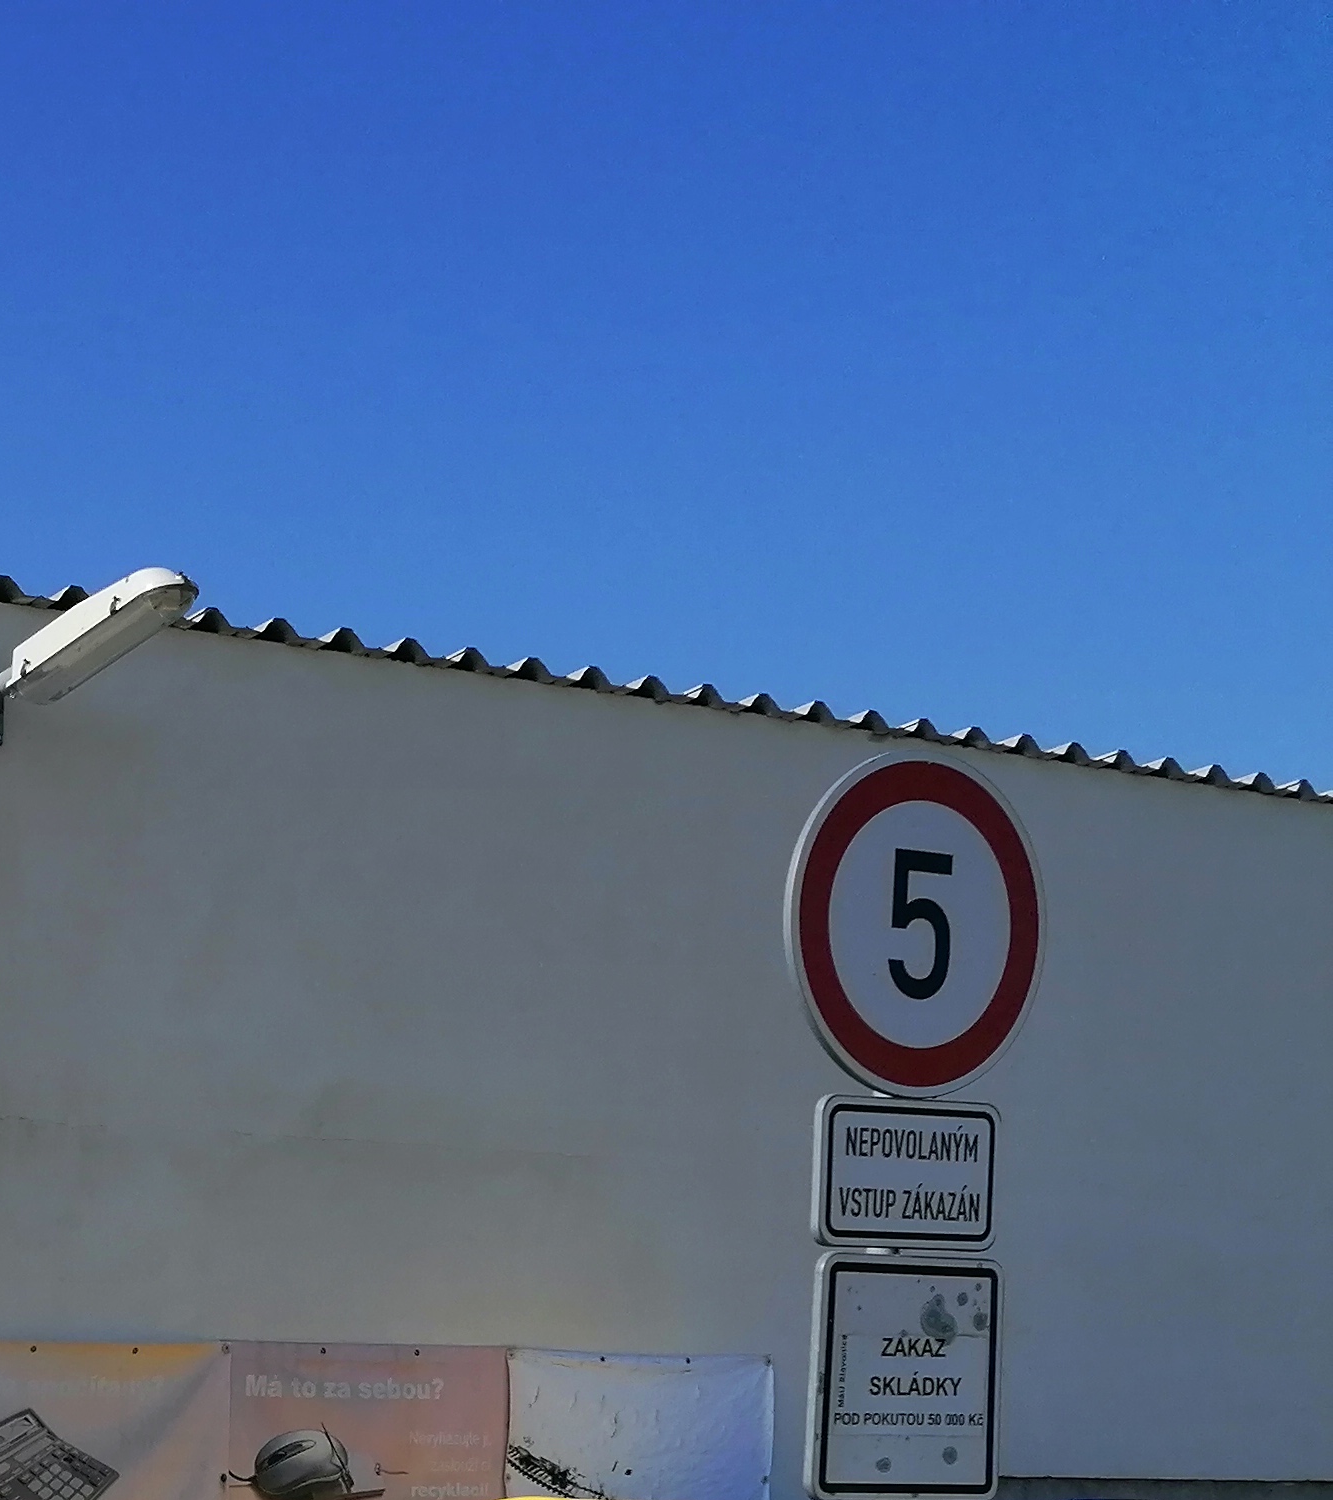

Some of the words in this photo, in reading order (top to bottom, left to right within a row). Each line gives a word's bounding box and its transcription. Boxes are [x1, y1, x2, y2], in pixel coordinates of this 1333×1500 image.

[887, 848, 954, 1000] 5
[845, 1125, 979, 1163] NEPOVOLANÝM
[839, 1186, 896, 1218] VSTUP
[902, 1183, 980, 1222] ZÁKAZÁN
[245, 1374, 282, 1398] Má
[291, 1377, 316, 1398] to
[323, 1381, 351, 1399] za
[359, 1377, 444, 1400] sebou?
[869, 1371, 962, 1396] SKLÁDKY
[834, 1413, 860, 1425] POD
[864, 1413, 925, 1425] POKUTOU
[927, 1413, 941, 1426] 50
